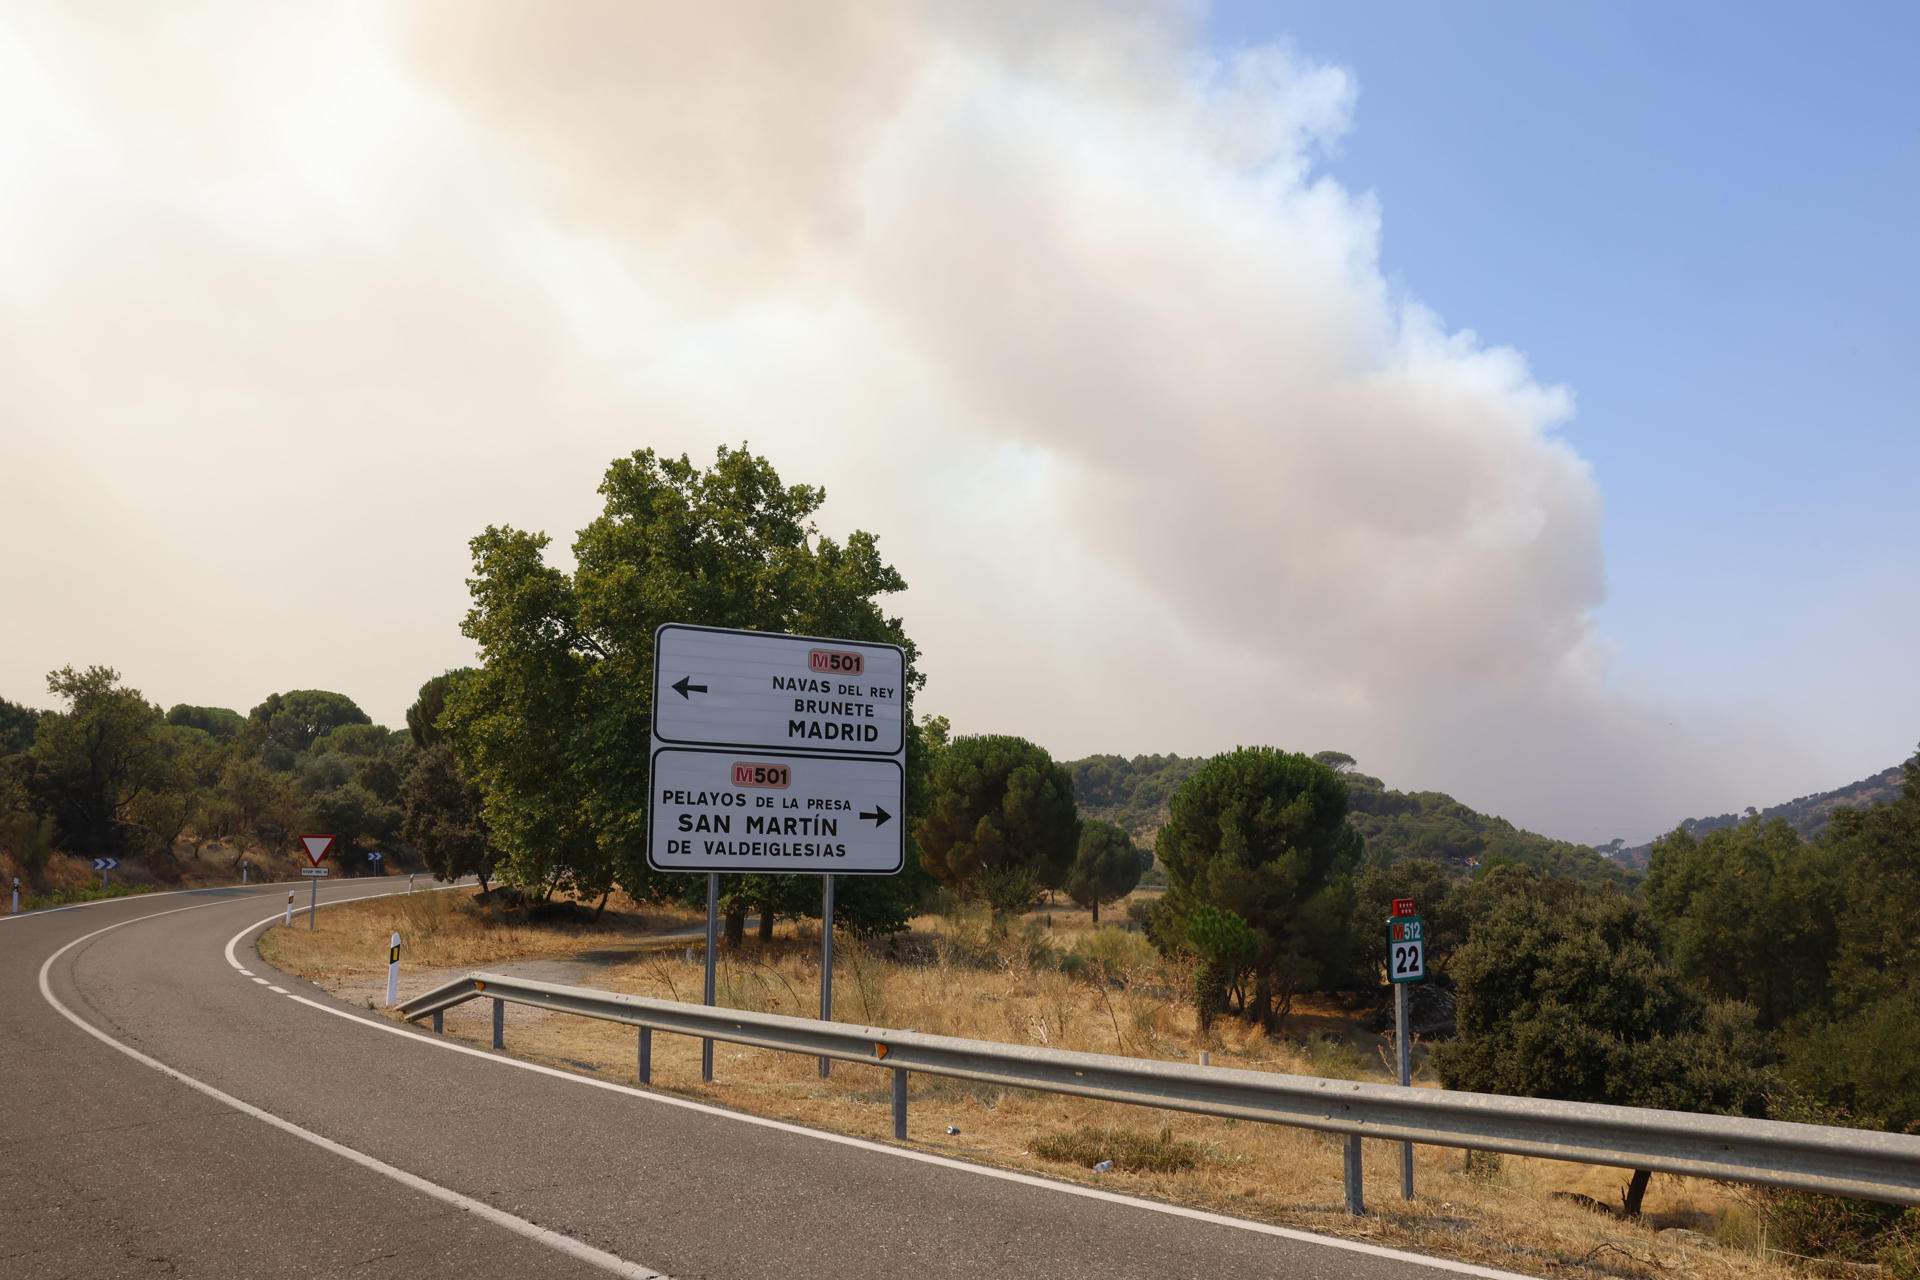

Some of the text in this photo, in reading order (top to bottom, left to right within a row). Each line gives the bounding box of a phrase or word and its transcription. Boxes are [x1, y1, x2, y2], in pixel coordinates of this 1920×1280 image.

[813, 653, 861, 671] M501
[772, 676, 894, 699] NAVAS DEL REY
[794, 699, 874, 718] BRUNETE
[788, 720, 878, 742] MADRID
[736, 767, 787, 785] M501
[663, 790, 851, 811] PELAYOS DE LA PRESA
[678, 813, 837, 837] SAN MARTÍN
[667, 840, 846, 857] DE VALDEIGLESIAS
[1393, 921, 1420, 941] M512
[1396, 945, 1419, 974] 22
